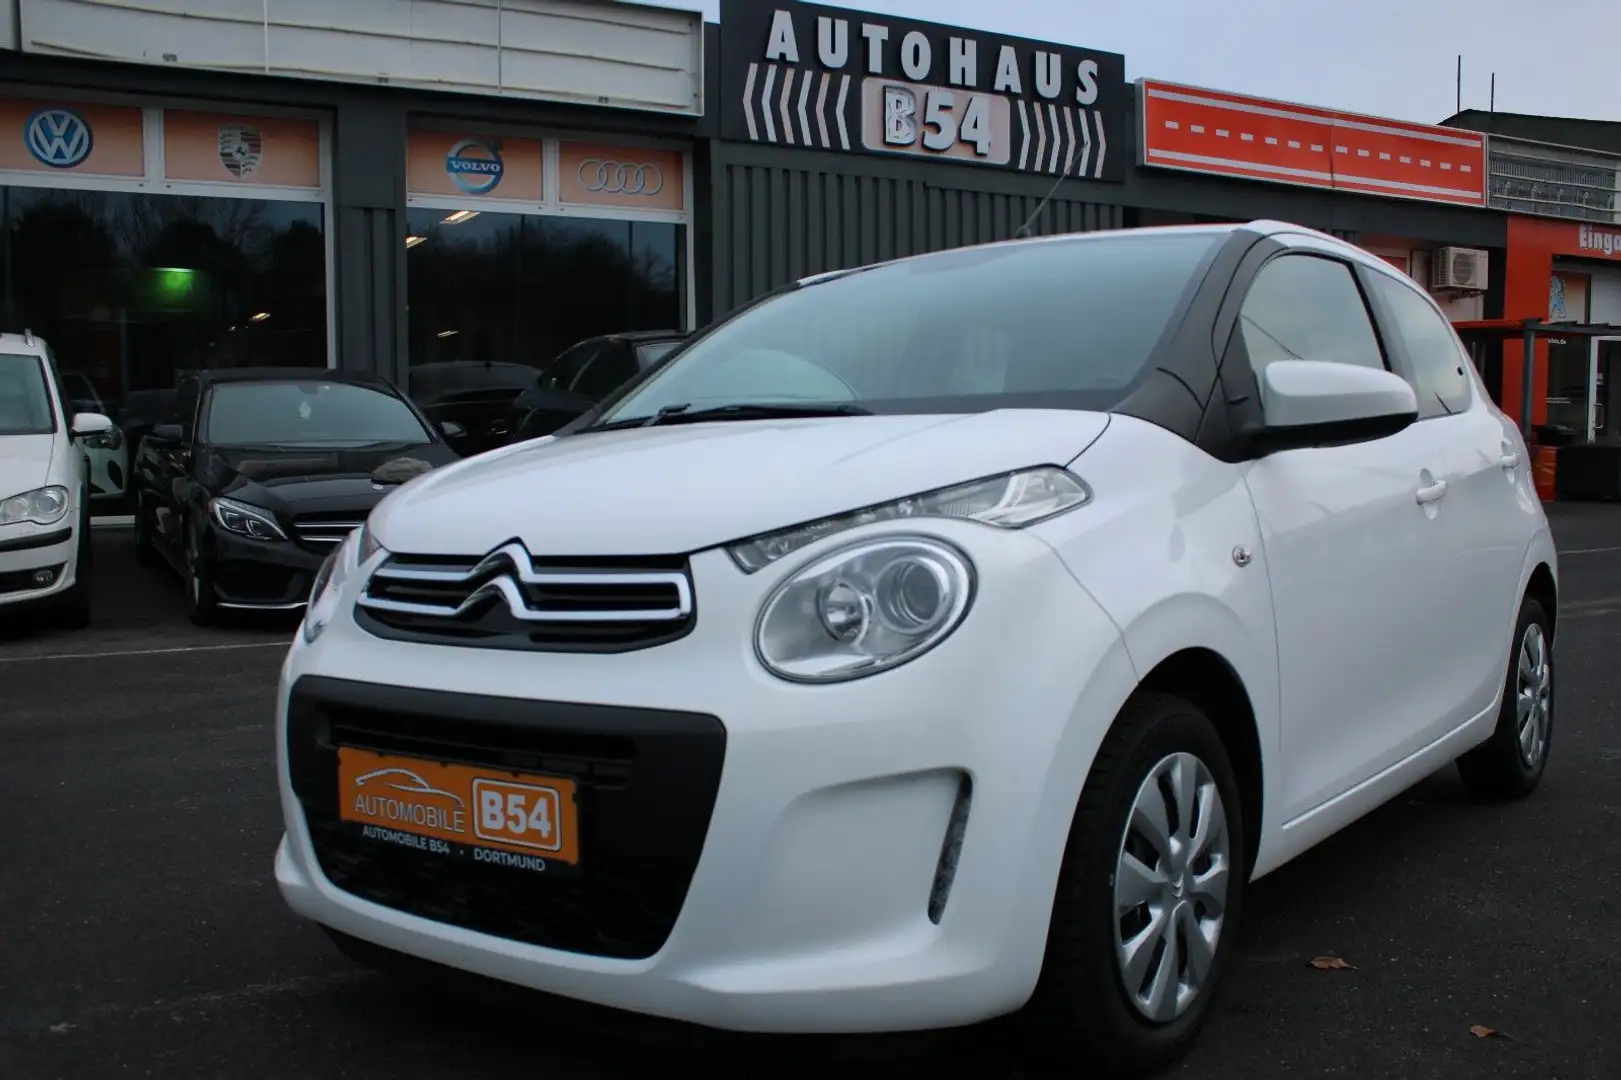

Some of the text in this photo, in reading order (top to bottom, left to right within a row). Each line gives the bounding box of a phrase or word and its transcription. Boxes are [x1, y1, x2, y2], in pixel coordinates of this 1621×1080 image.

[765, 9, 1100, 106] AUTOHAUS
[882, 84, 993, 157] B54
[450, 160, 501, 172] VOLVO
[354, 790, 552, 839] AUTOMOBILE B54
[362, 825, 546, 872] AUTOMOBILE B54 DORTMUND
